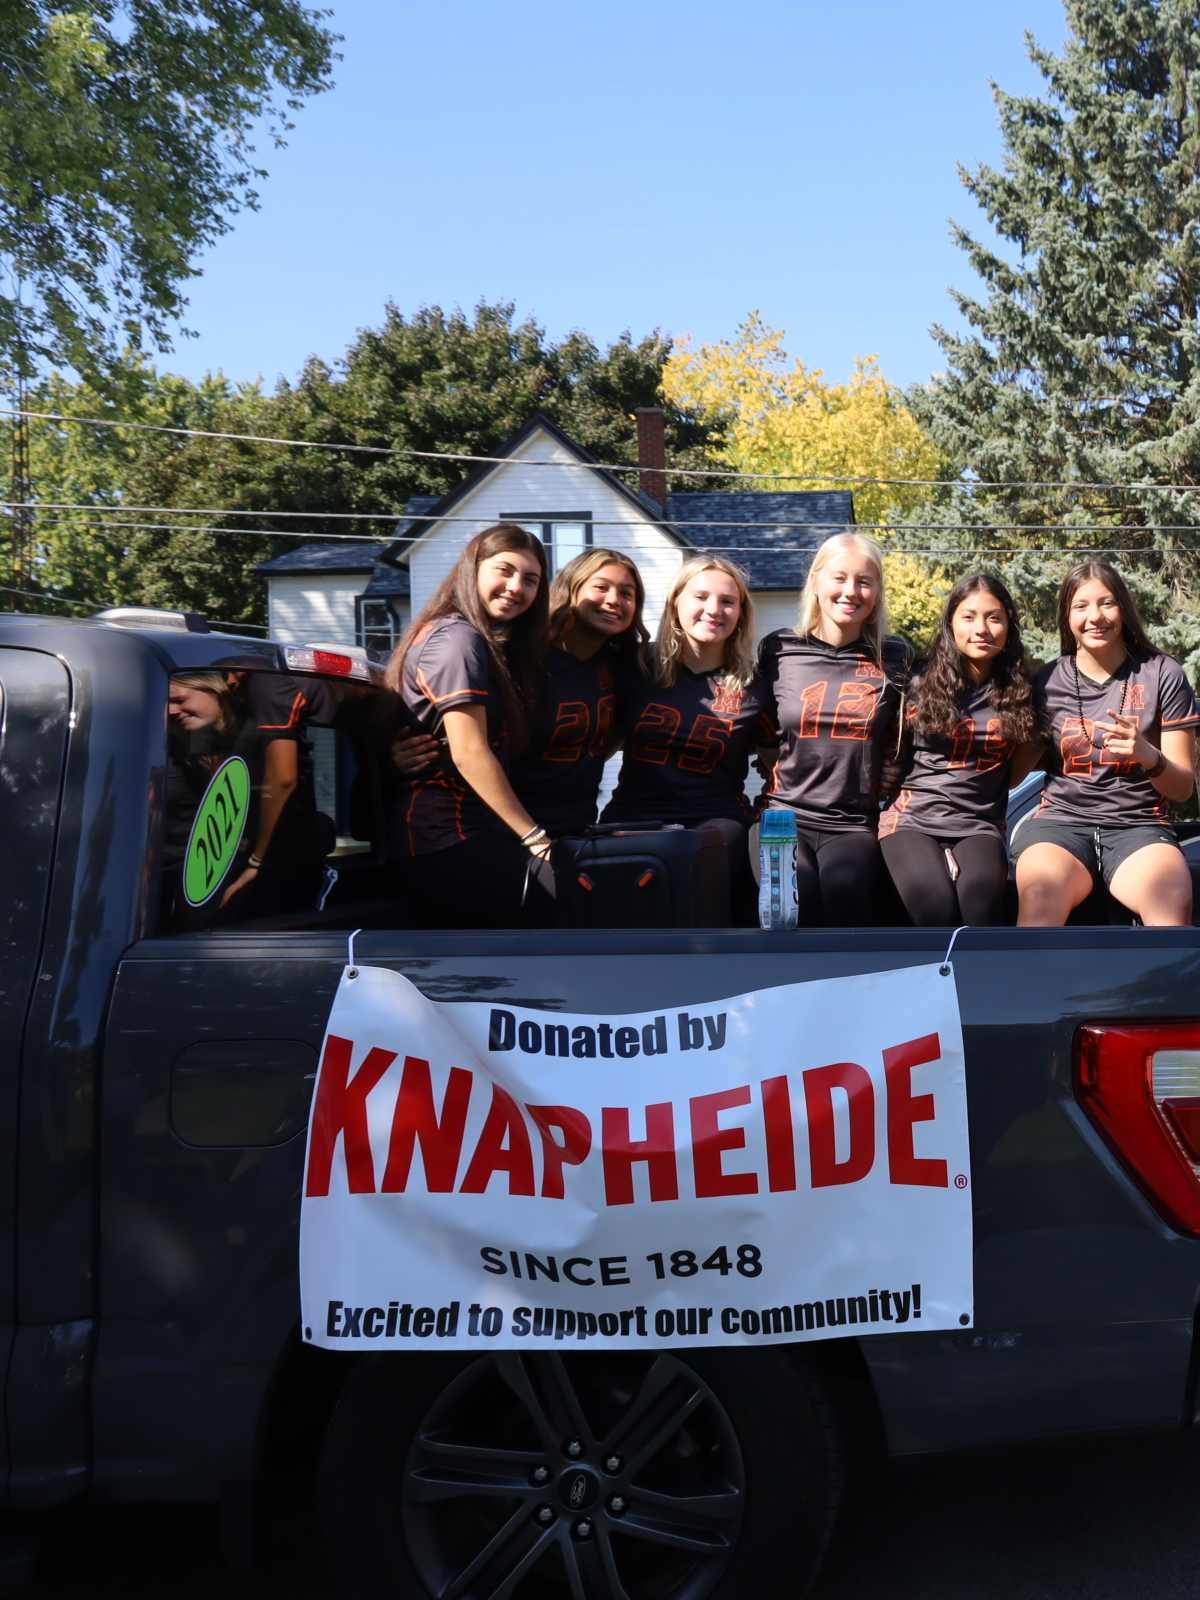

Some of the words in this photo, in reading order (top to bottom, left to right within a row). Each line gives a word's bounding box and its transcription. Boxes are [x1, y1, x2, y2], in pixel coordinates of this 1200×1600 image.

[711, 686, 743, 715] M
[799, 681, 876, 740] 12
[1120, 684, 1144, 709] M
[633, 702, 735, 774] 25
[196, 770, 241, 890] 2021
[488, 1008, 668, 1058] Donated
[677, 1012, 727, 1051] by
[480, 1246, 631, 1287] SINCE
[645, 1243, 763, 1280] 1848
[326, 1300, 460, 1338] Excited
[468, 1303, 503, 1337] to
[511, 1305, 648, 1340] support
[654, 1306, 713, 1338] our
[720, 1283, 922, 1335] community!
